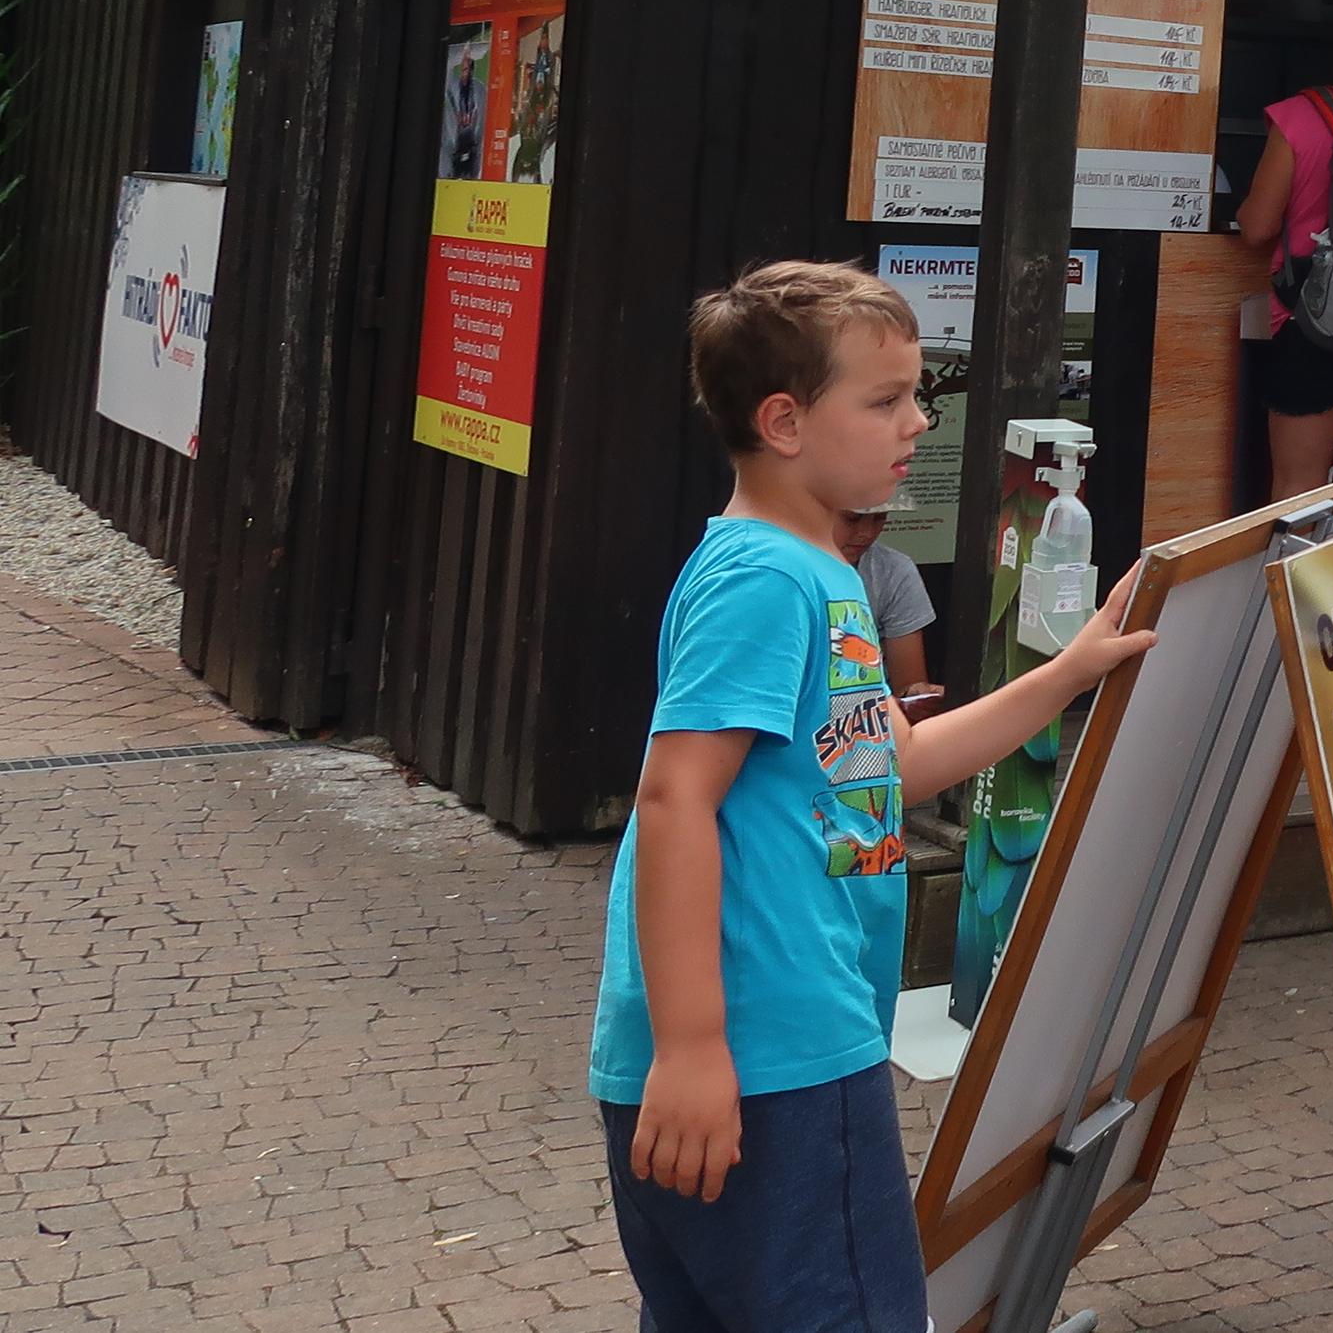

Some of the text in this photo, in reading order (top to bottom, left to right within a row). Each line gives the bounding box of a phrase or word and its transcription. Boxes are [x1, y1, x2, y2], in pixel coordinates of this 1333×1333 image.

[475, 199, 507, 226] RAPPA
[889, 258, 975, 276] NEKRMTE
[440, 410, 501, 445] www.rappa.cz
